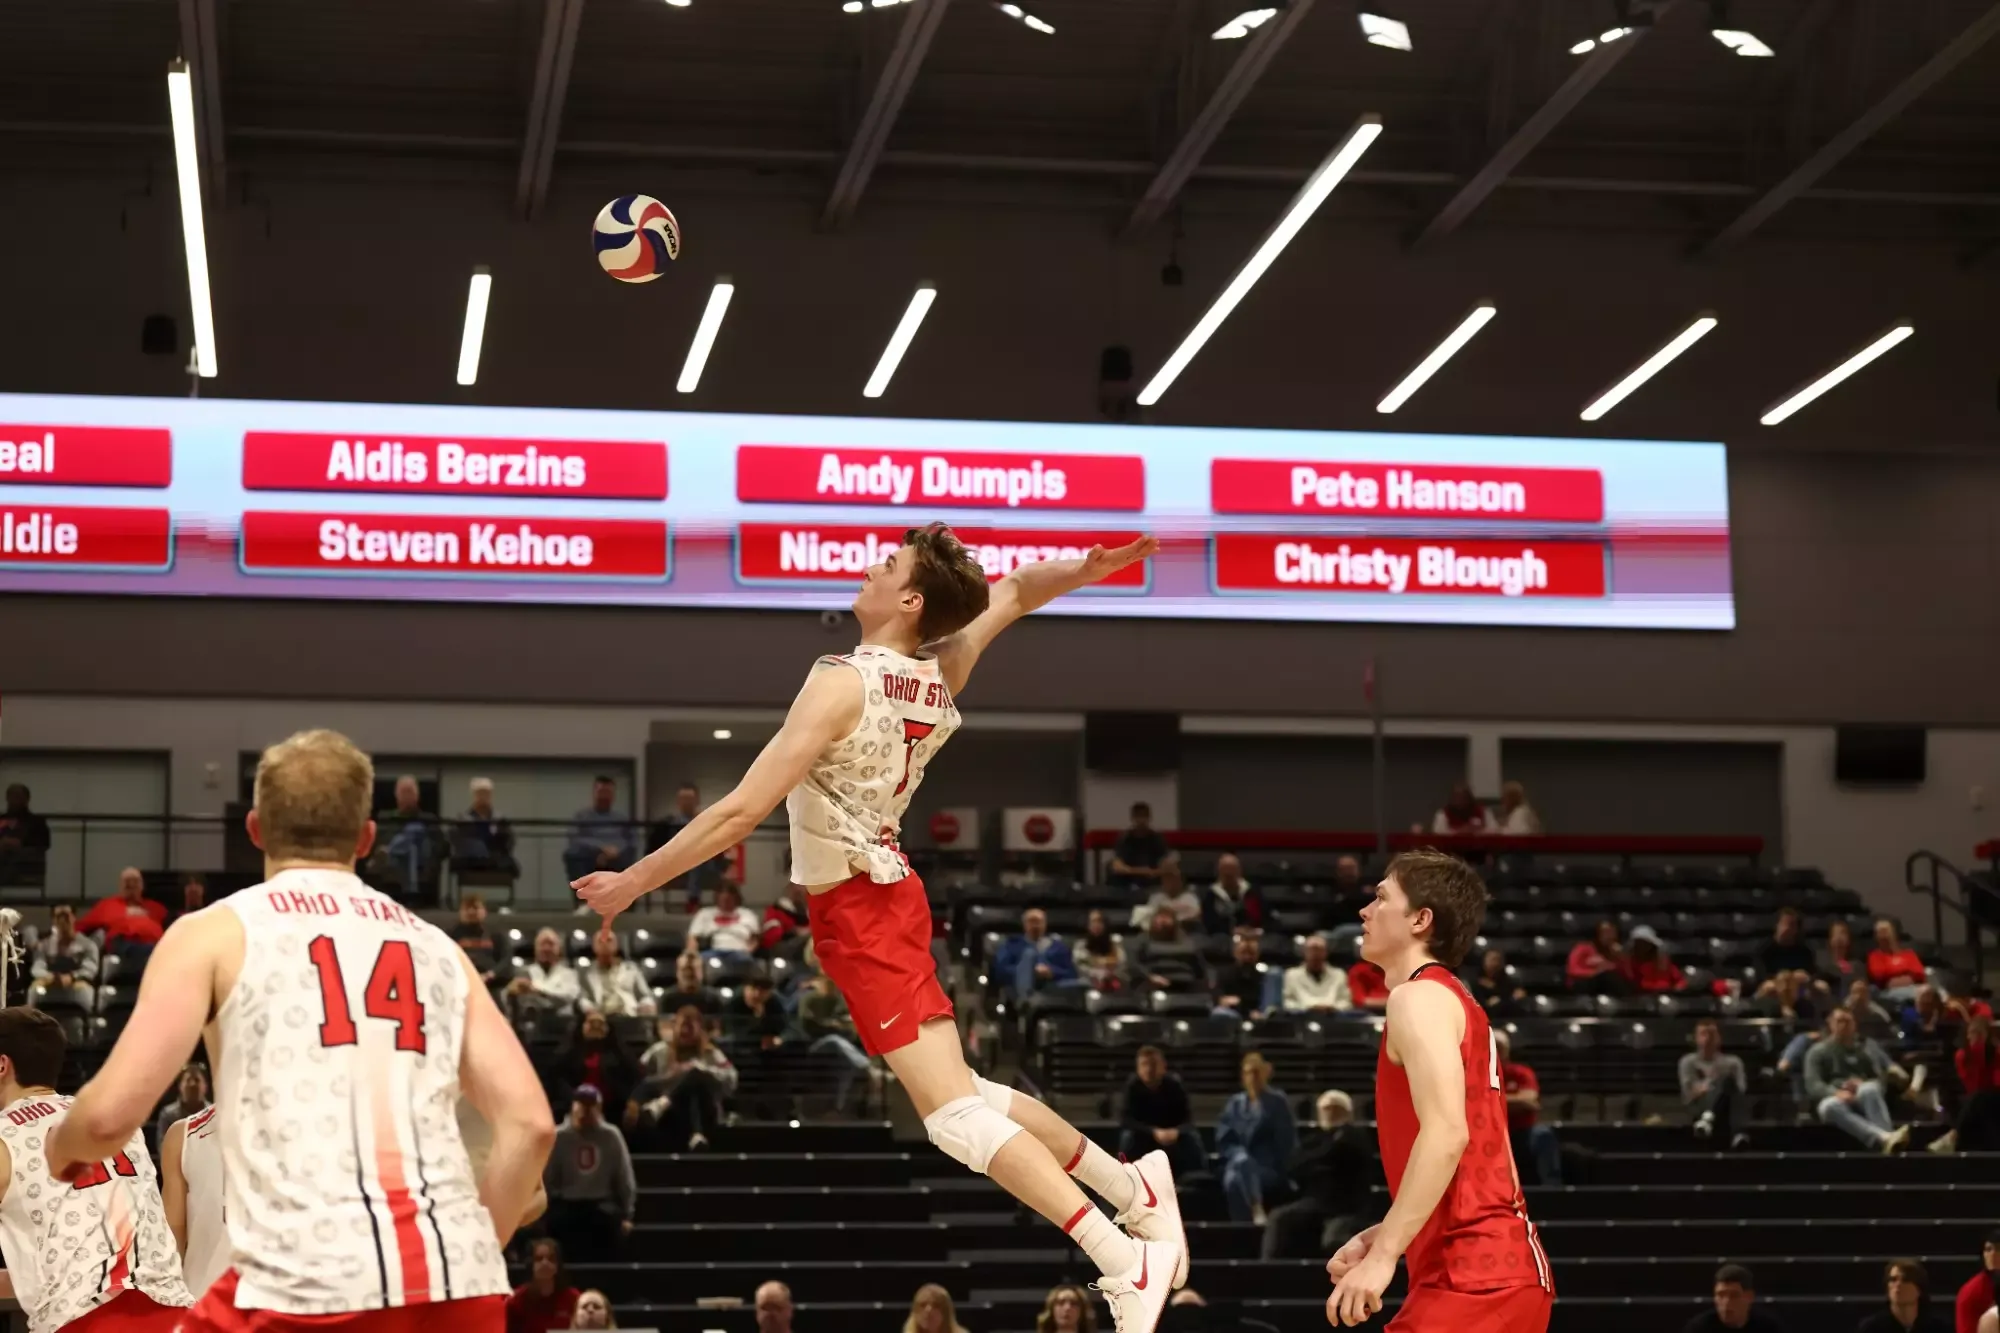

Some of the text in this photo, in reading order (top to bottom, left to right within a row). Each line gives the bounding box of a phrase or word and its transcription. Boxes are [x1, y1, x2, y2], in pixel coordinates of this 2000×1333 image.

[327, 440, 586, 487] Aldis Berzins
[817, 453, 1067, 506] Andy Dumpis
[1291, 467, 1526, 512] Pete Hanson
[319, 519, 593, 566] Steven Kehoe
[1274, 543, 1547, 596] Christy Blough
[883, 673, 921, 703] OHIO
[892, 718, 937, 798] 7
[268, 890, 423, 932] OHIO STATE
[308, 934, 427, 1056] 14
[7, 1102, 57, 1126] OHIO
